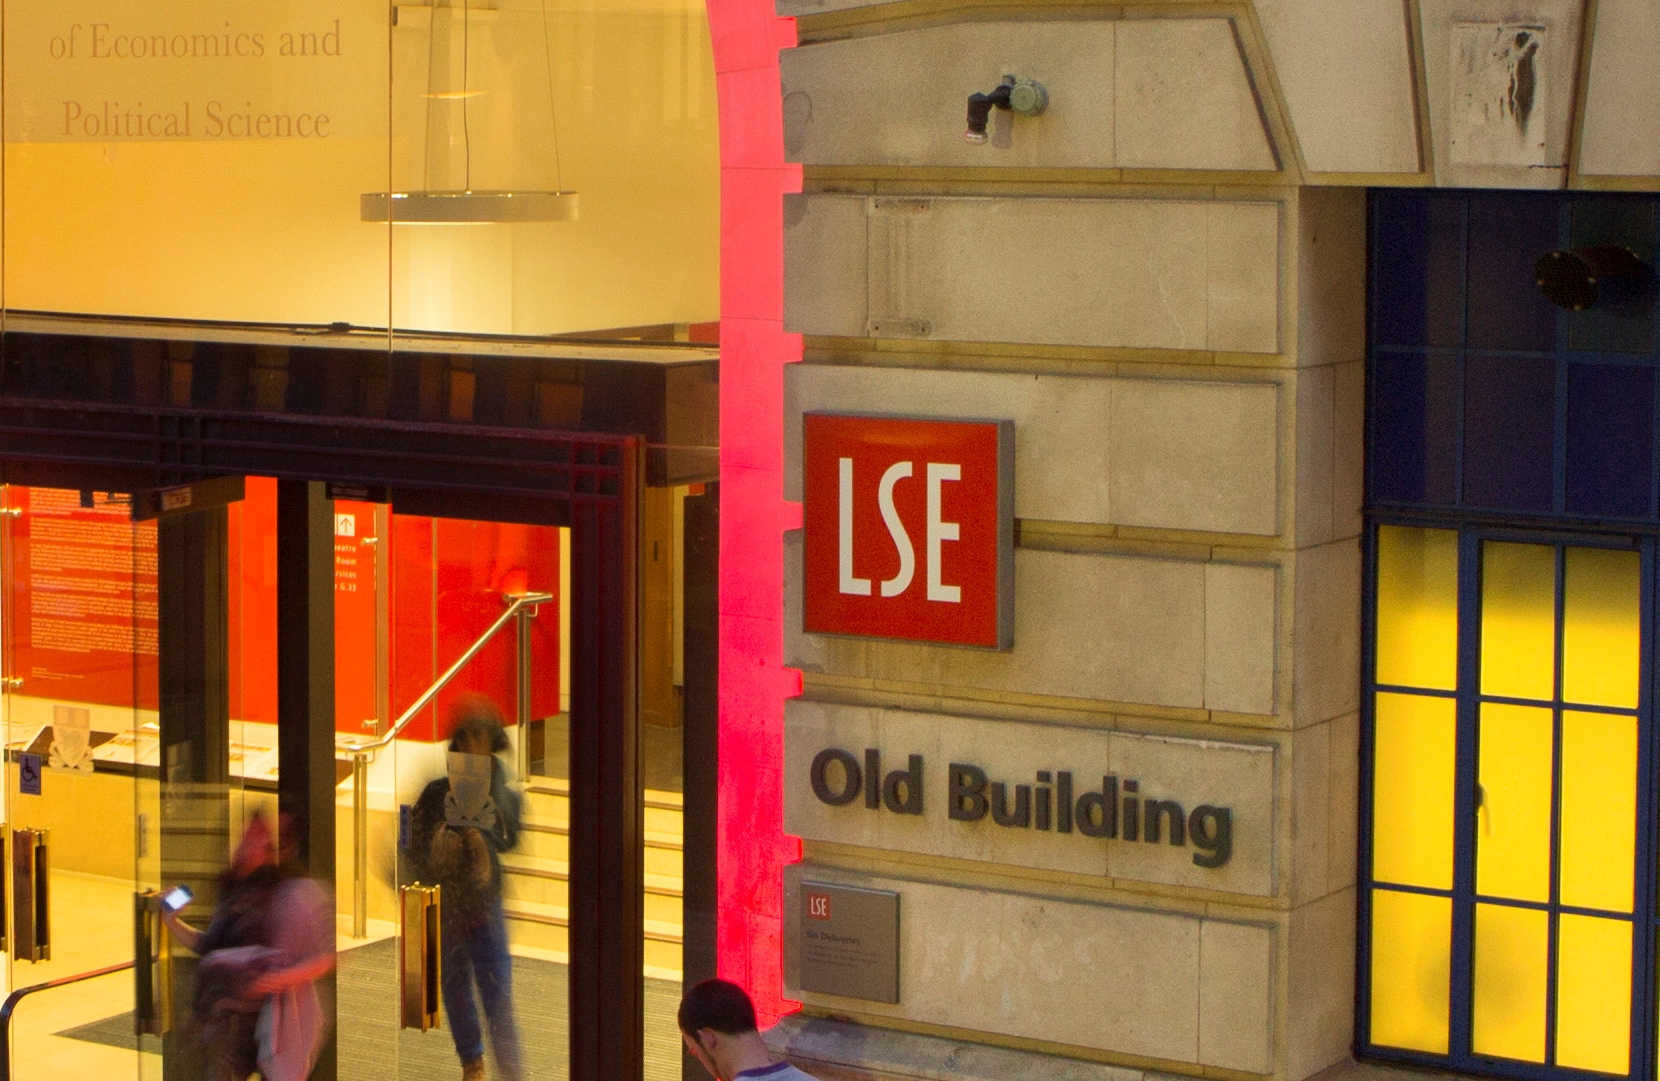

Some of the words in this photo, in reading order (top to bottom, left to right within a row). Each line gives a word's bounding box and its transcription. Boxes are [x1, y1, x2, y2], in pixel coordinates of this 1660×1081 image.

[49, 24, 82, 59] of
[89, 21, 265, 60] Economics
[279, 19, 342, 57] and
[61, 101, 190, 138] Political
[205, 100, 331, 138] Science
[838, 457, 962, 604] LSE
[810, 747, 924, 816] Old
[948, 763, 1234, 869] Building
[810, 896, 827, 916] LSE
[806, 929, 818, 940] No
